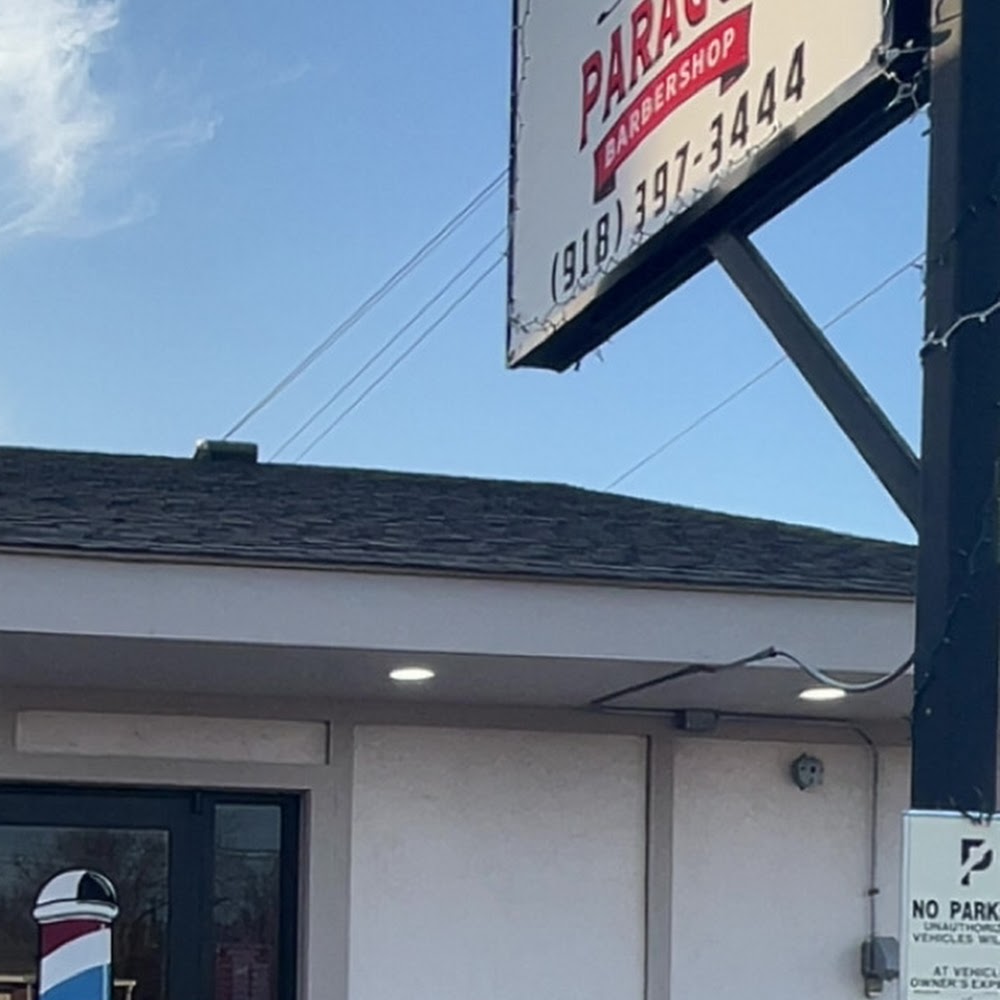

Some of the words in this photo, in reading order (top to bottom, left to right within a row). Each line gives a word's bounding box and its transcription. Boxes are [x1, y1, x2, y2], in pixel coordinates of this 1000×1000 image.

[579, 0, 728, 152] PARA
[604, 26, 736, 168] BARBERSHOP
[551, 198, 623, 304] (918)
[634, 43, 806, 234] 397-3444
[912, 899, 940, 919] NO
[949, 900, 1000, 921] PARK
[912, 932, 973, 944] VEHICLES
[933, 965, 949, 977] AT
